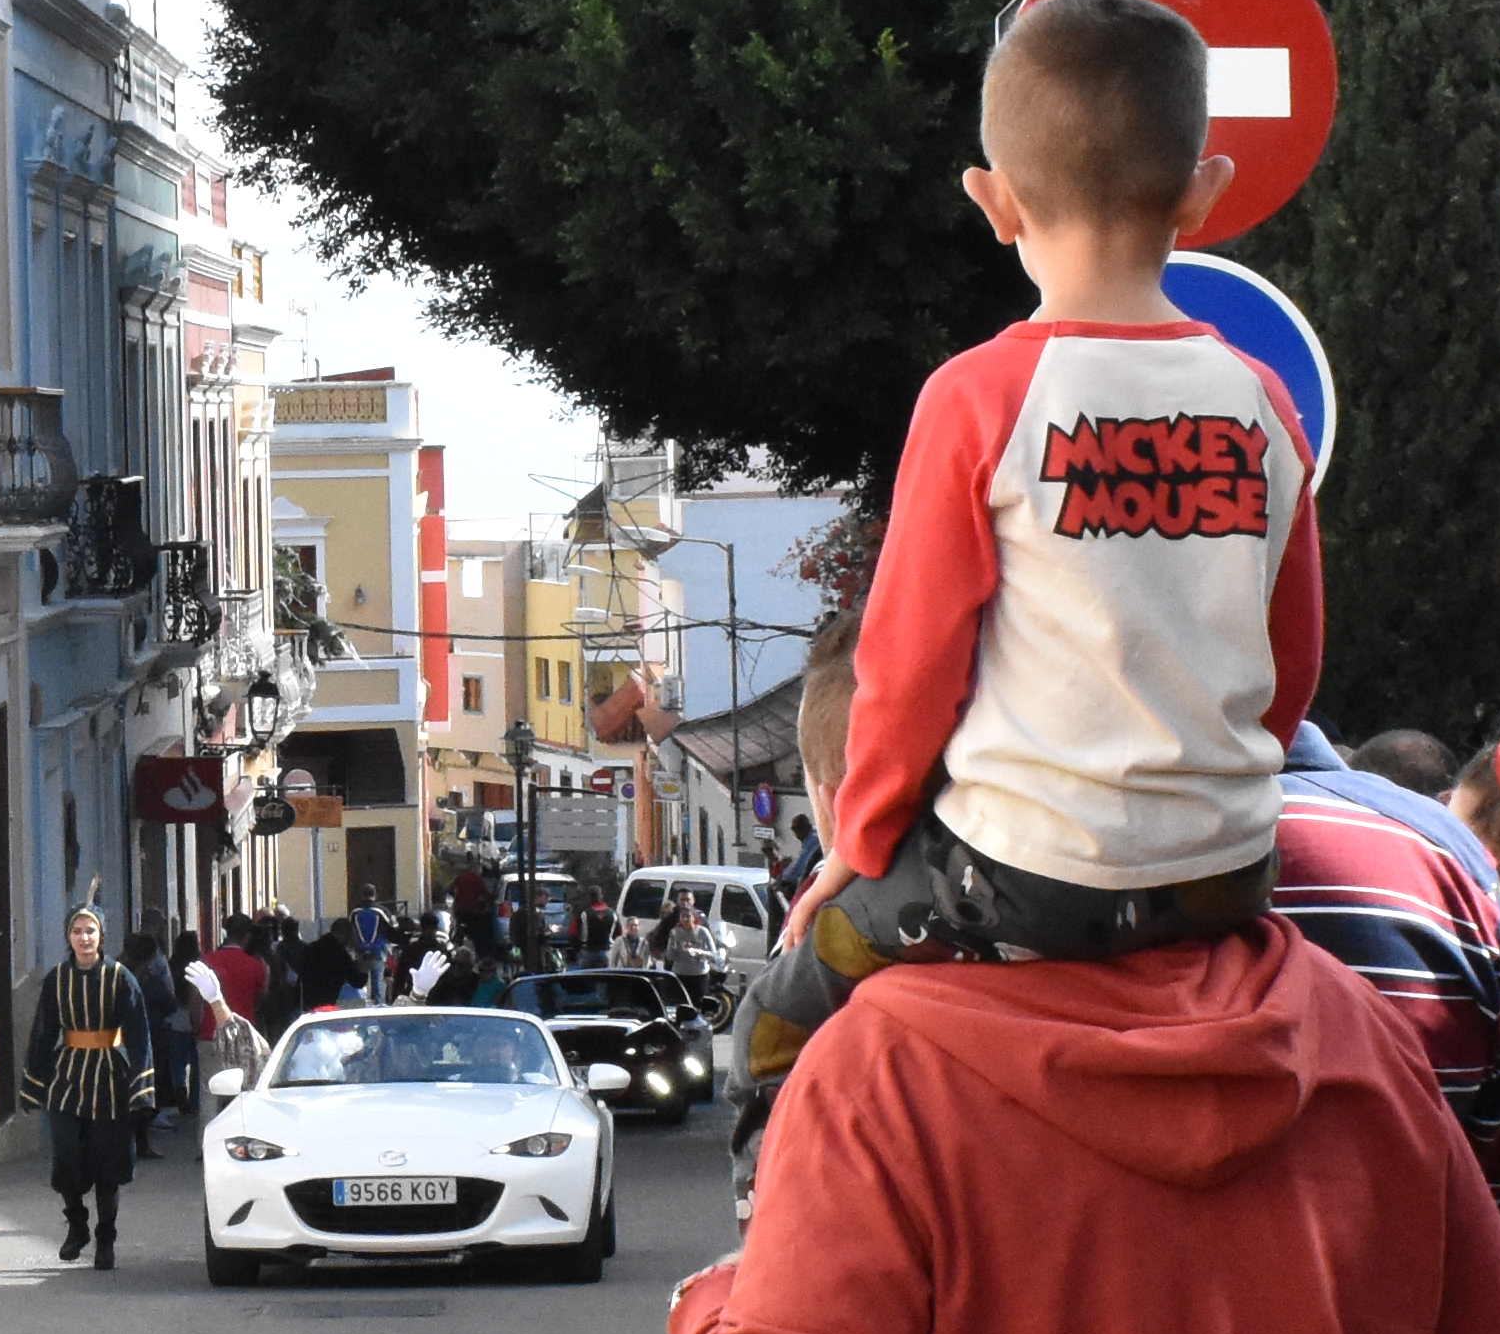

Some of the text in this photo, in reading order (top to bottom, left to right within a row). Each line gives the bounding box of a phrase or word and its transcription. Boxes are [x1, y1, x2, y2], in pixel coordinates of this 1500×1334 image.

[1042, 412, 1269, 479] MICKEY
[1054, 473, 1268, 539] MOUSE
[350, 1182, 450, 1202] 9566 KGY
